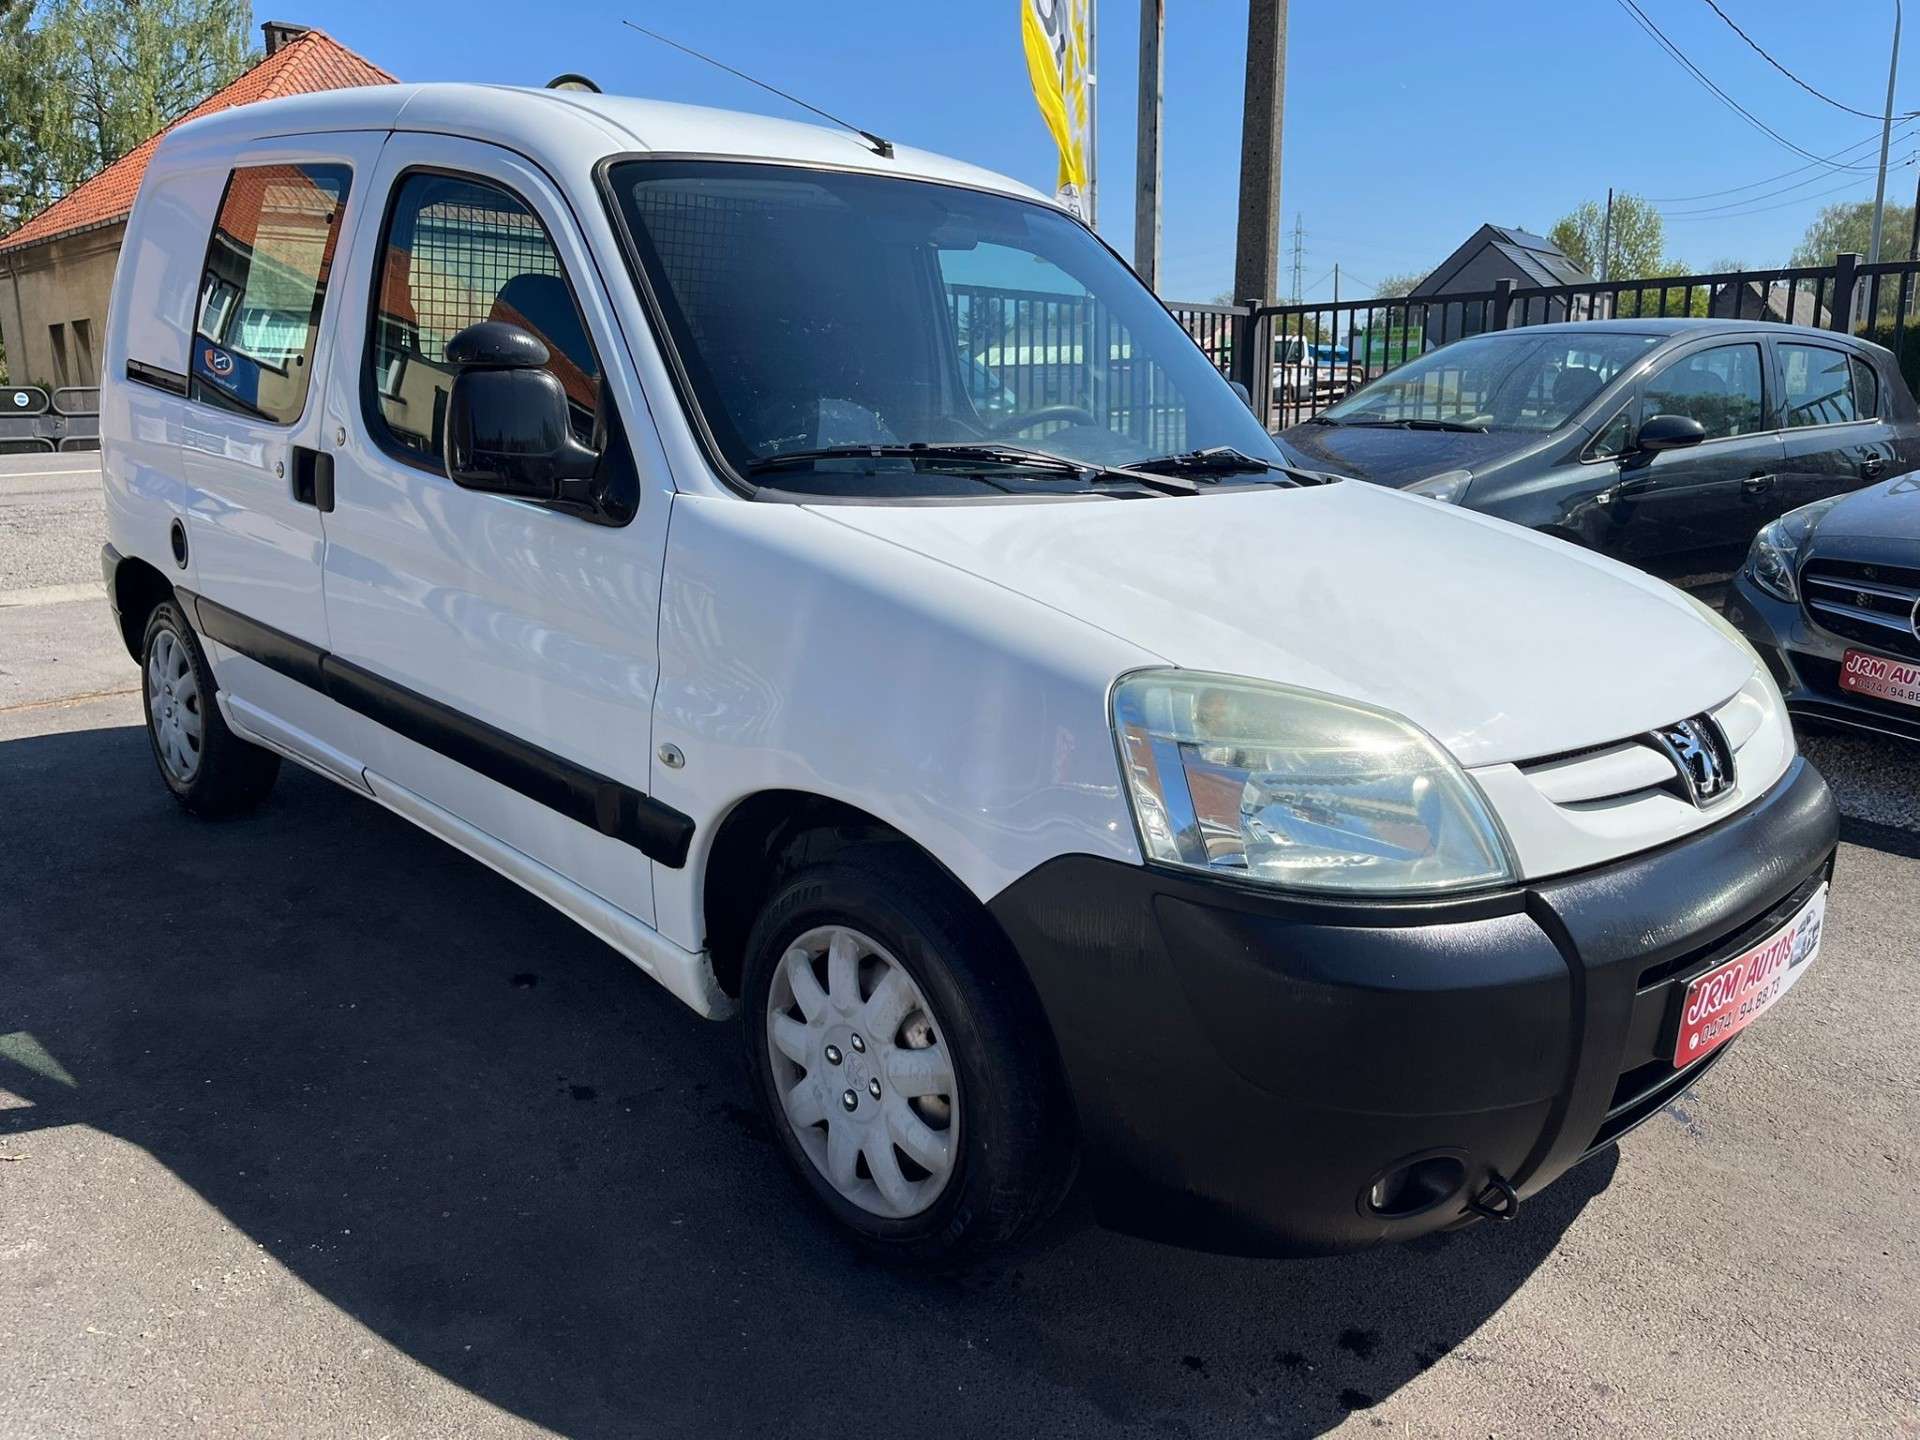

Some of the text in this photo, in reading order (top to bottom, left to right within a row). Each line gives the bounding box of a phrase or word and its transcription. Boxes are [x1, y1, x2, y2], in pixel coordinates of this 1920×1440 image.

[1846, 655, 1888, 680] JRM
[1687, 928, 1796, 1025] JRM AUTOS
